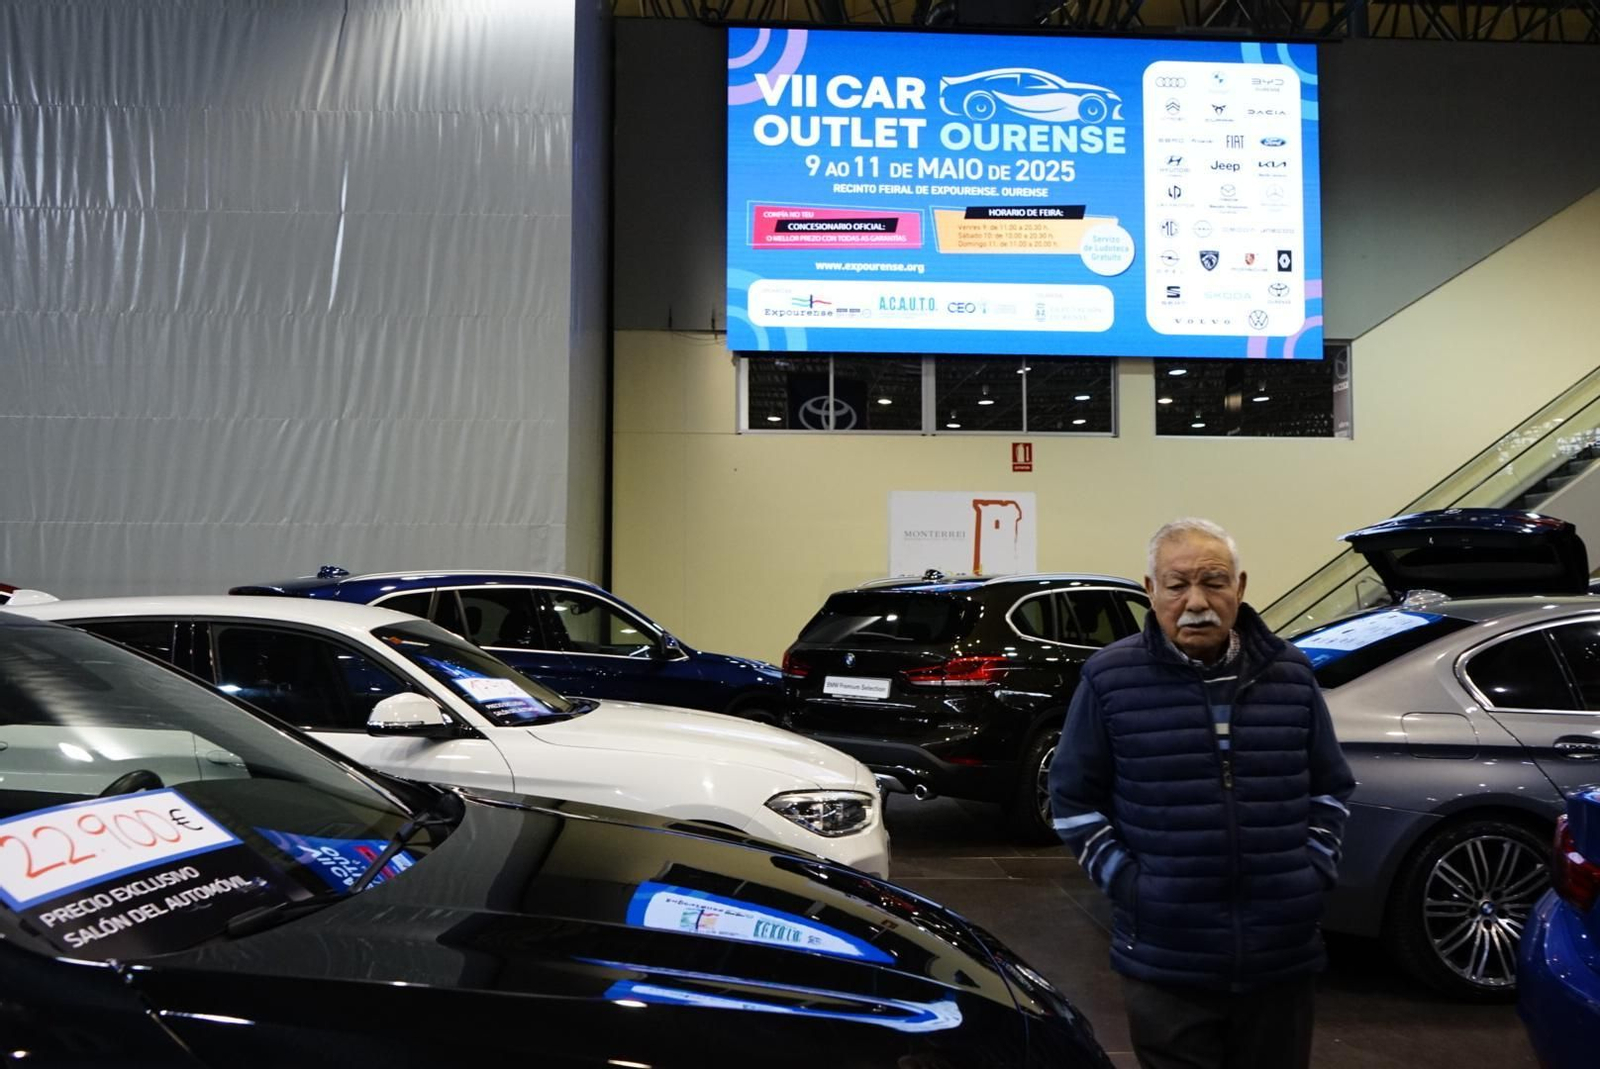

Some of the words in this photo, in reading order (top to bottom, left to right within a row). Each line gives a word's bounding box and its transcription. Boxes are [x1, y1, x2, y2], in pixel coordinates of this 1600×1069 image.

[754, 73, 817, 107] VII
[826, 75, 927, 109] CAR
[753, 114, 927, 149] OUTLET
[940, 121, 1126, 154] OURENSE
[1226, 135, 1244, 149] FIAT
[805, 154, 821, 177] 9
[825, 161, 849, 177] AO
[854, 155, 879, 178] 11
[890, 163, 913, 178] DE
[918, 157, 983, 180] MAIO
[988, 165, 1011, 181] DE
[1015, 160, 1076, 182] 2025
[1210, 160, 1240, 172] Jeep
[833, 183, 876, 194] RECINTO
[878, 184, 913, 195] FEIRAL
[915, 185, 929, 195] DE
[1001, 187, 1049, 198] OURENSE
[988, 209, 1025, 217] HORARIO
[1026, 209, 1038, 217] DE
[1039, 209, 1064, 217] FEIRA:
[787, 222, 852, 231] CONCESIONARIO
[853, 222, 886, 231] OFICIAL:
[815, 262, 925, 274] www.expourense.org
[764, 308, 834, 318] Expourense
[947, 302, 976, 313] CEO
[904, 530, 966, 538] MONTERREI
[39, 892, 112, 928] PRECIO
[109, 865, 200, 903] EXCLUSIVO
[63, 914, 133, 949] SALÓN
[129, 902, 169, 924] DEL
[166, 873, 252, 912] AUTOMÓVIL
